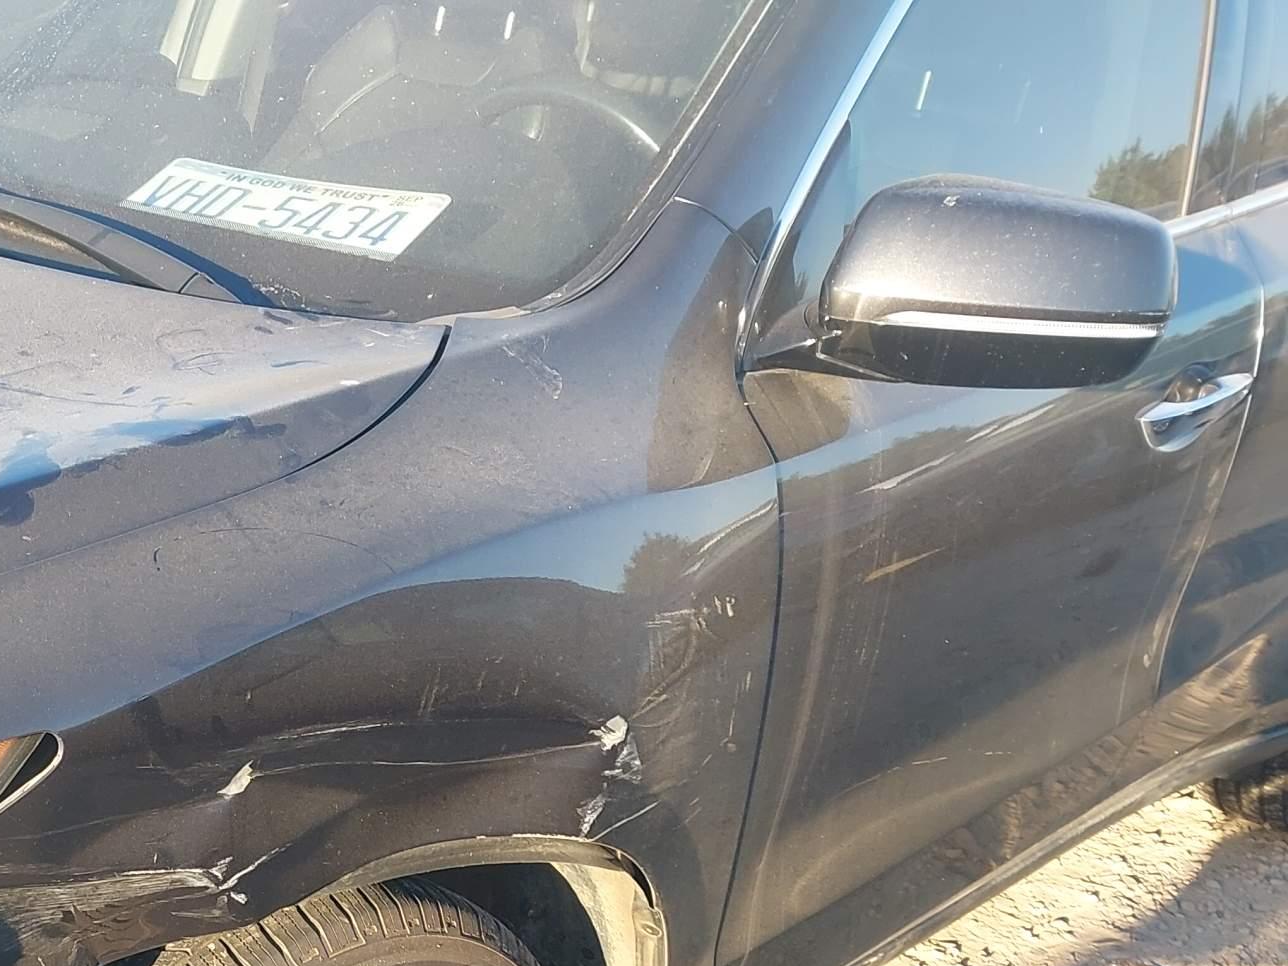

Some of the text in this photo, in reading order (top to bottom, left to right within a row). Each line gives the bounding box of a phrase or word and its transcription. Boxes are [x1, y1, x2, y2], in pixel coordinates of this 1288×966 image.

[248, 176, 288, 189] GOD
[289, 182, 316, 194] WE
[142, 175, 409, 246] VHD-5434
